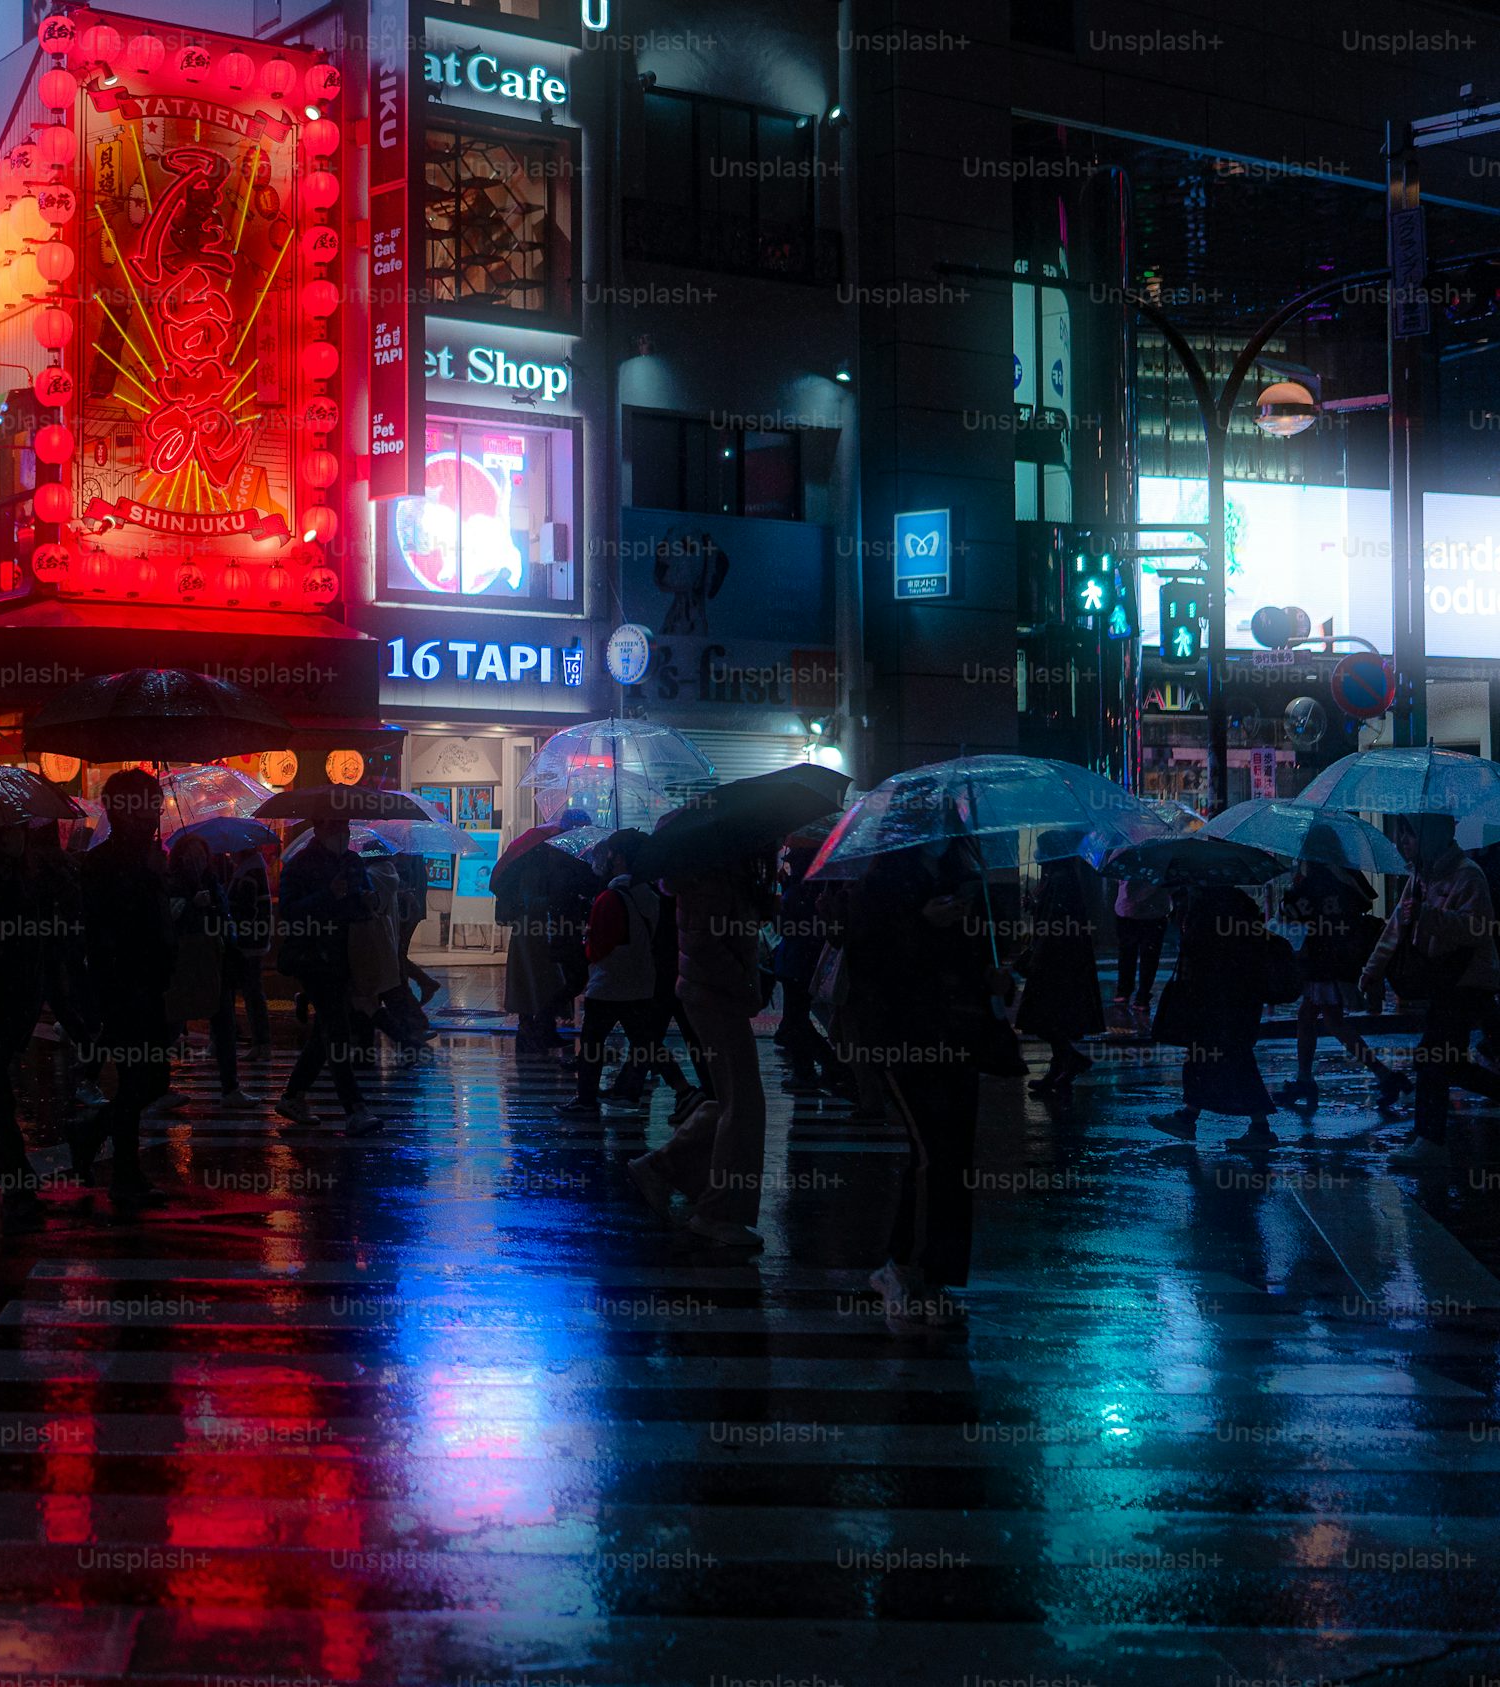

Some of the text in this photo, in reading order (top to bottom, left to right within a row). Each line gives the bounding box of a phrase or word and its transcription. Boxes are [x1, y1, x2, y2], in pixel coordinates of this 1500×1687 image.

[466, 53, 568, 104] Cafe
[134, 98, 250, 134] YATAIEN
[374, 243, 396, 258] Cat
[374, 259, 403, 276] Cafe
[376, 323, 387, 334] 2F
[374, 335, 392, 350] 16
[374, 349, 403, 366] TAPI
[468, 348, 568, 402] Shop
[373, 413, 384, 424] 1F
[373, 424, 395, 439] Pet
[372, 440, 404, 456] Shop
[128, 505, 247, 534] SHINJUKU
[386, 636, 552, 684] 16 TAPI
[565, 659, 581, 675] 16
